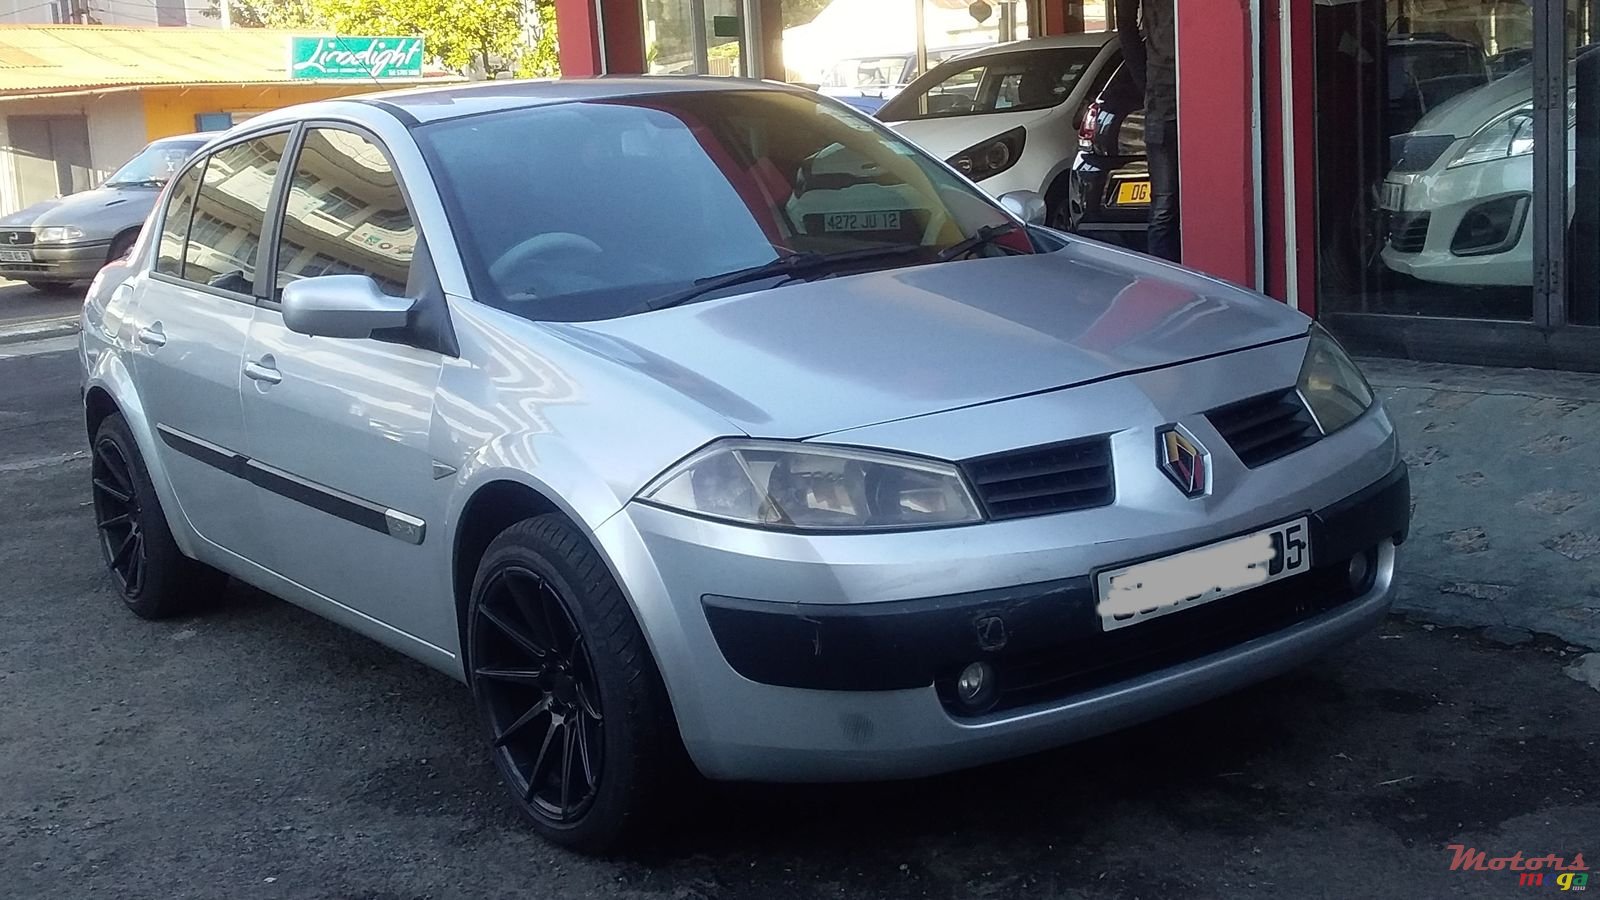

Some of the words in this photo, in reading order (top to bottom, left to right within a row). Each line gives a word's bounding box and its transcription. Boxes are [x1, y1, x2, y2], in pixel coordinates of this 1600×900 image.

[827, 214, 857, 230] 4272
[861, 213, 877, 228] JU
[883, 212, 897, 228] 12
